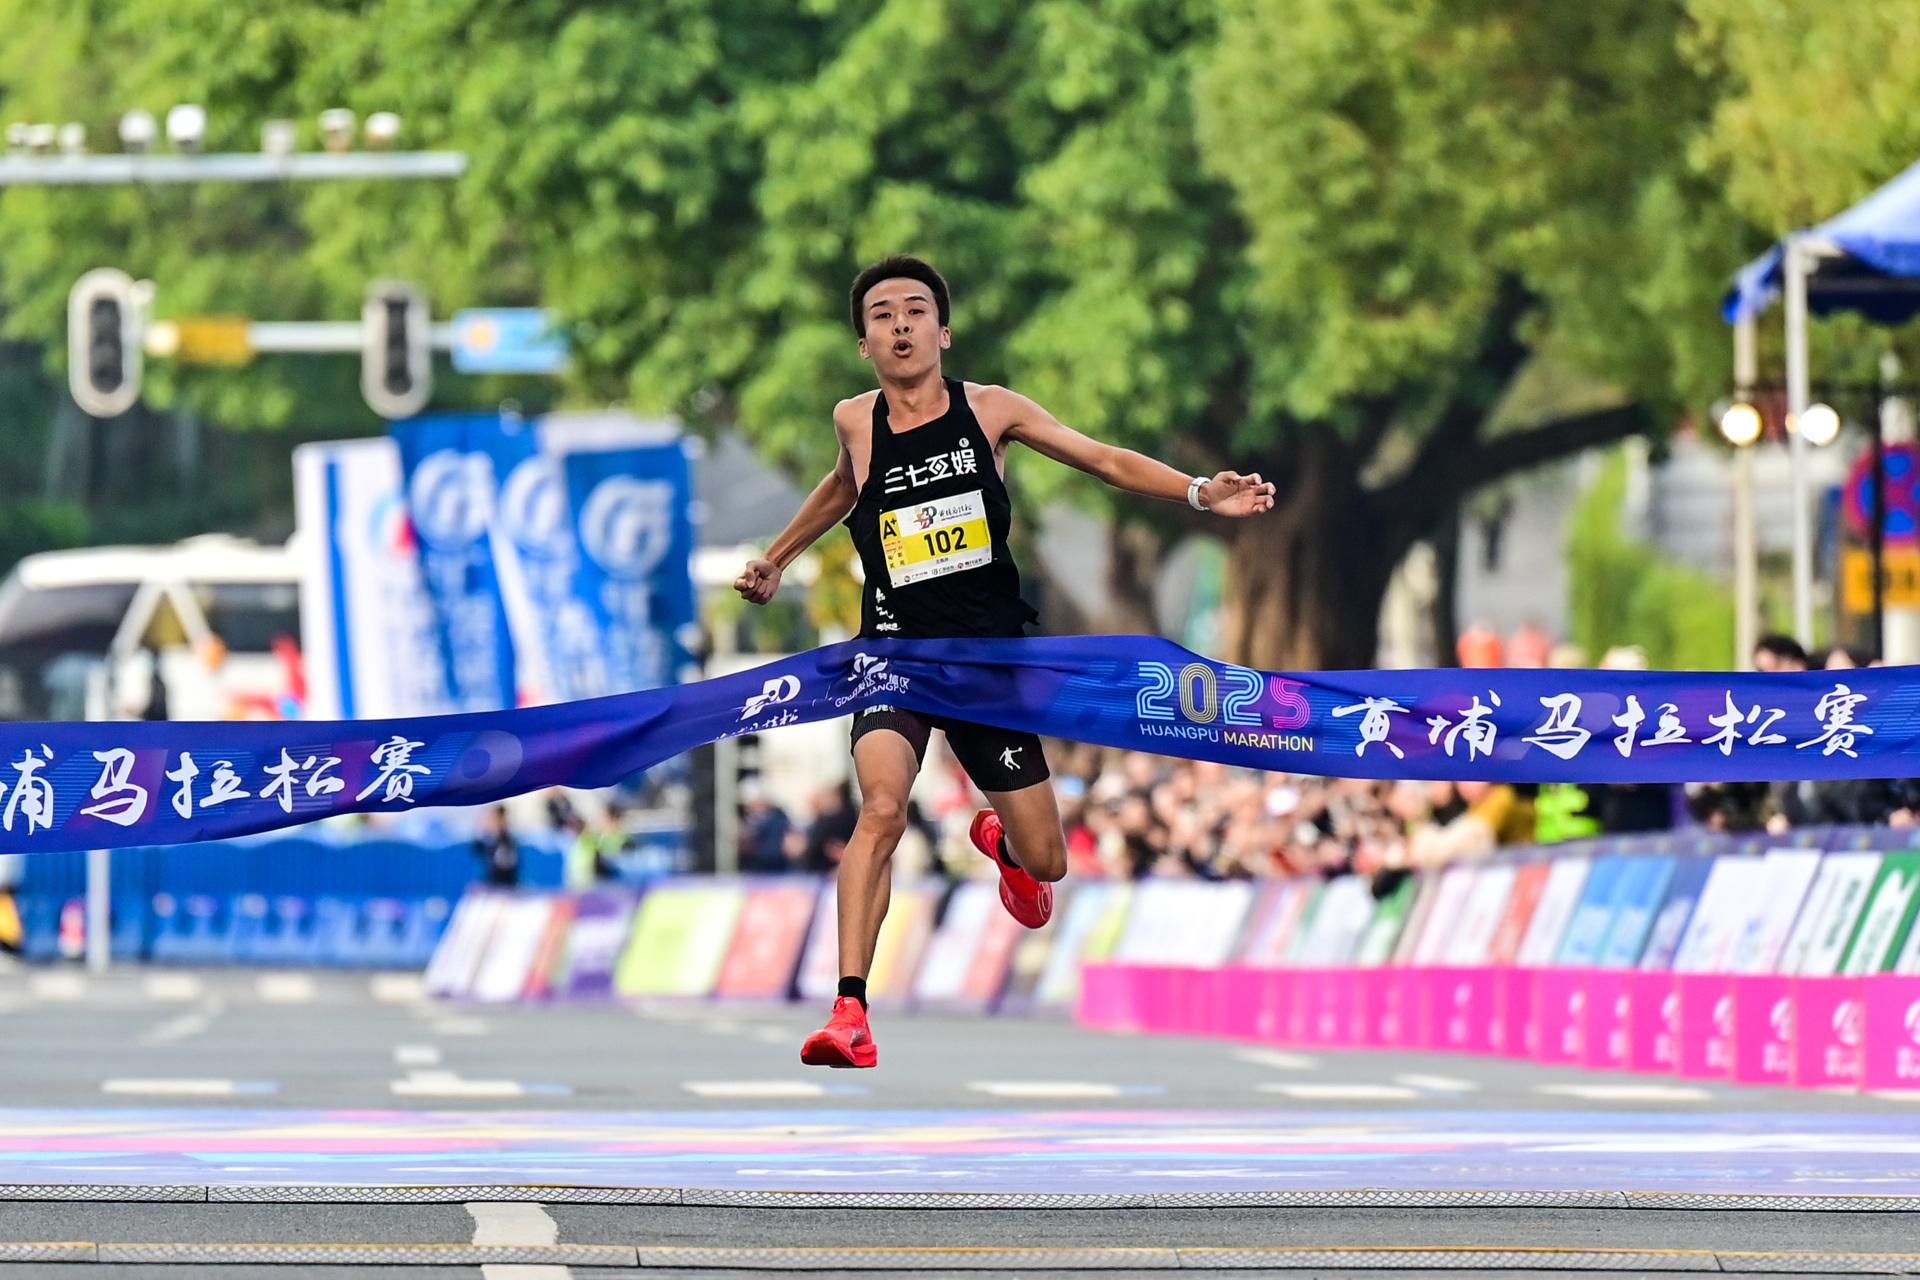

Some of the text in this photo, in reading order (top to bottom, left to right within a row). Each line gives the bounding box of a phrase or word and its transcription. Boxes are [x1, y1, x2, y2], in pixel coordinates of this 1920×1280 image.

[884, 448, 978, 494] 三七互娱
[924, 526, 968, 556] 102
[1136, 661, 1310, 730] 2025
[1140, 722, 1313, 753] HUANGPU MARATHON
